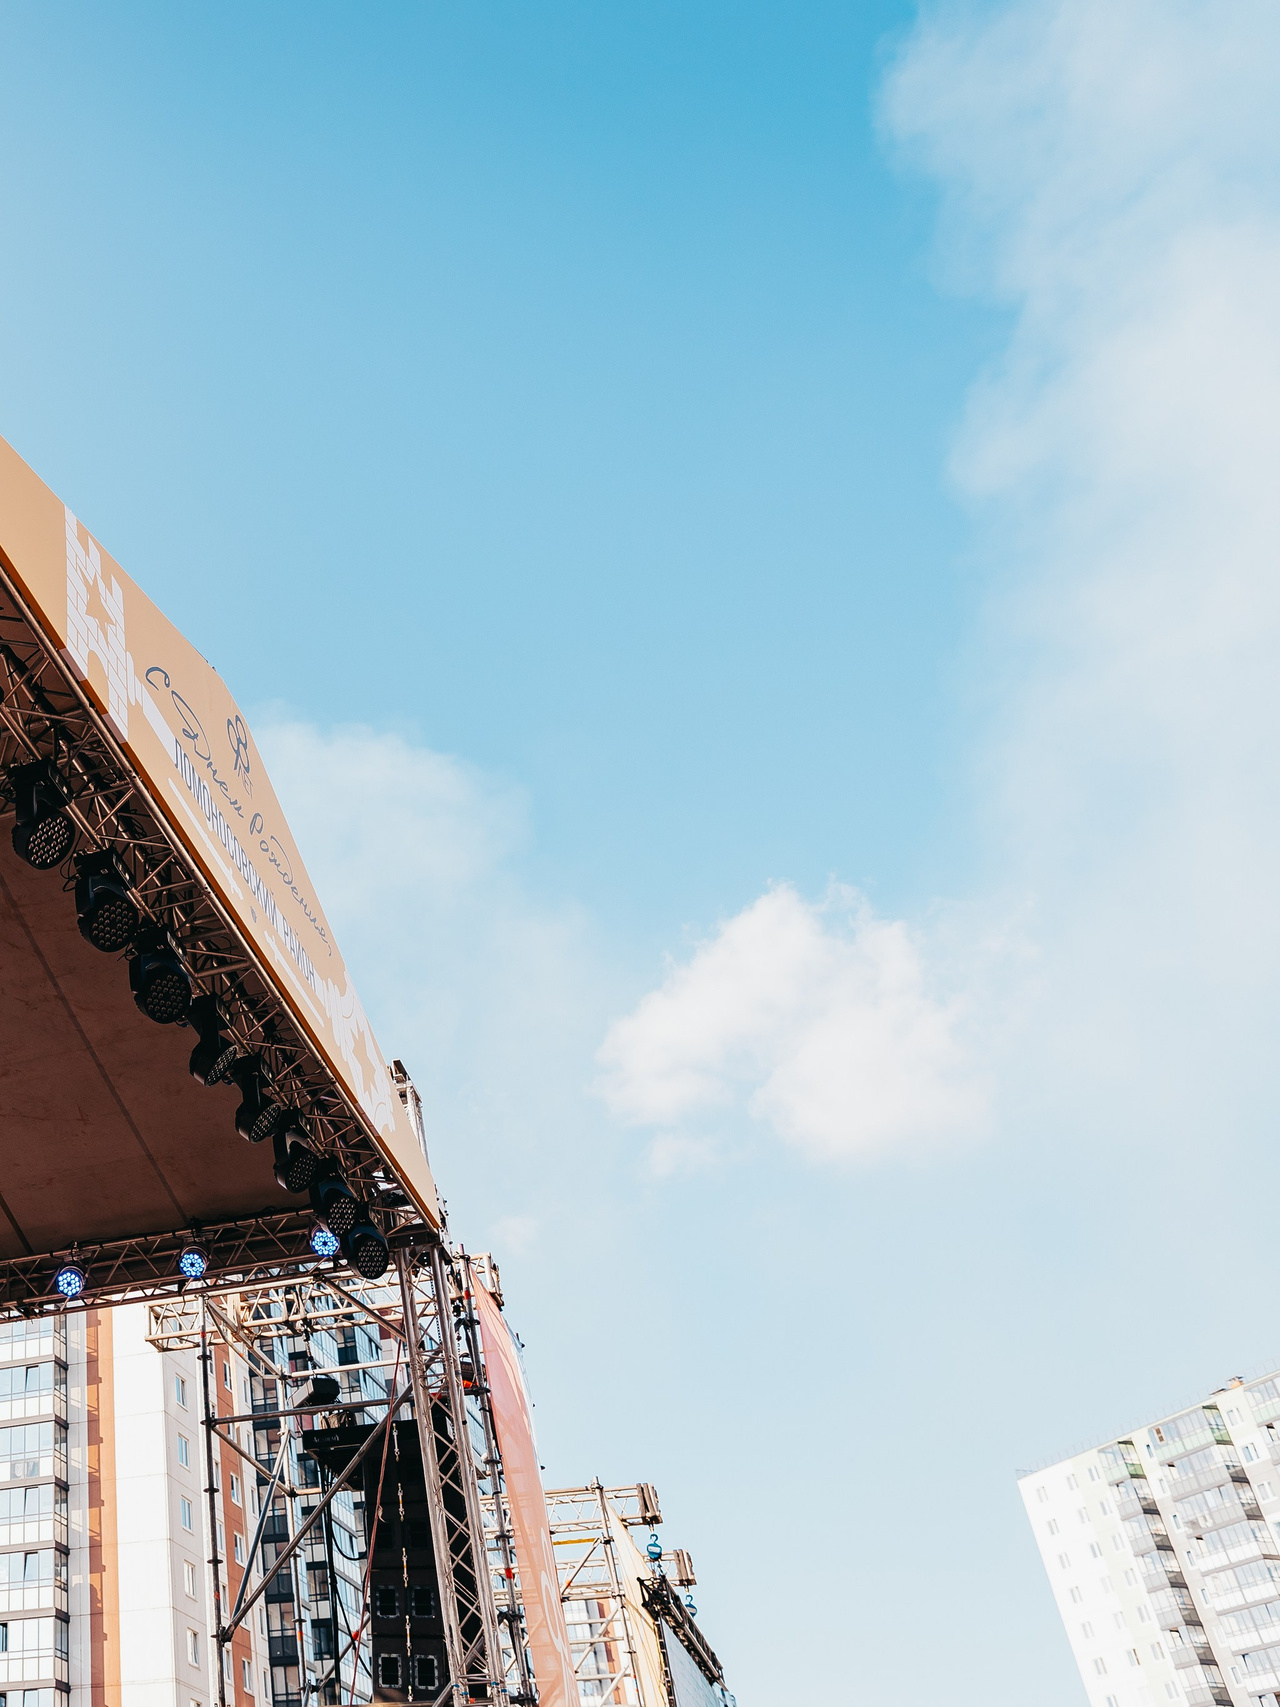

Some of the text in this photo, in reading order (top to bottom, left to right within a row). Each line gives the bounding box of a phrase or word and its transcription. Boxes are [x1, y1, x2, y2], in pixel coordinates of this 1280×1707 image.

[171, 690, 245, 819] Днем
[174, 737, 317, 993] ЛОМОНОСОВСКИЙ РАЙОН
